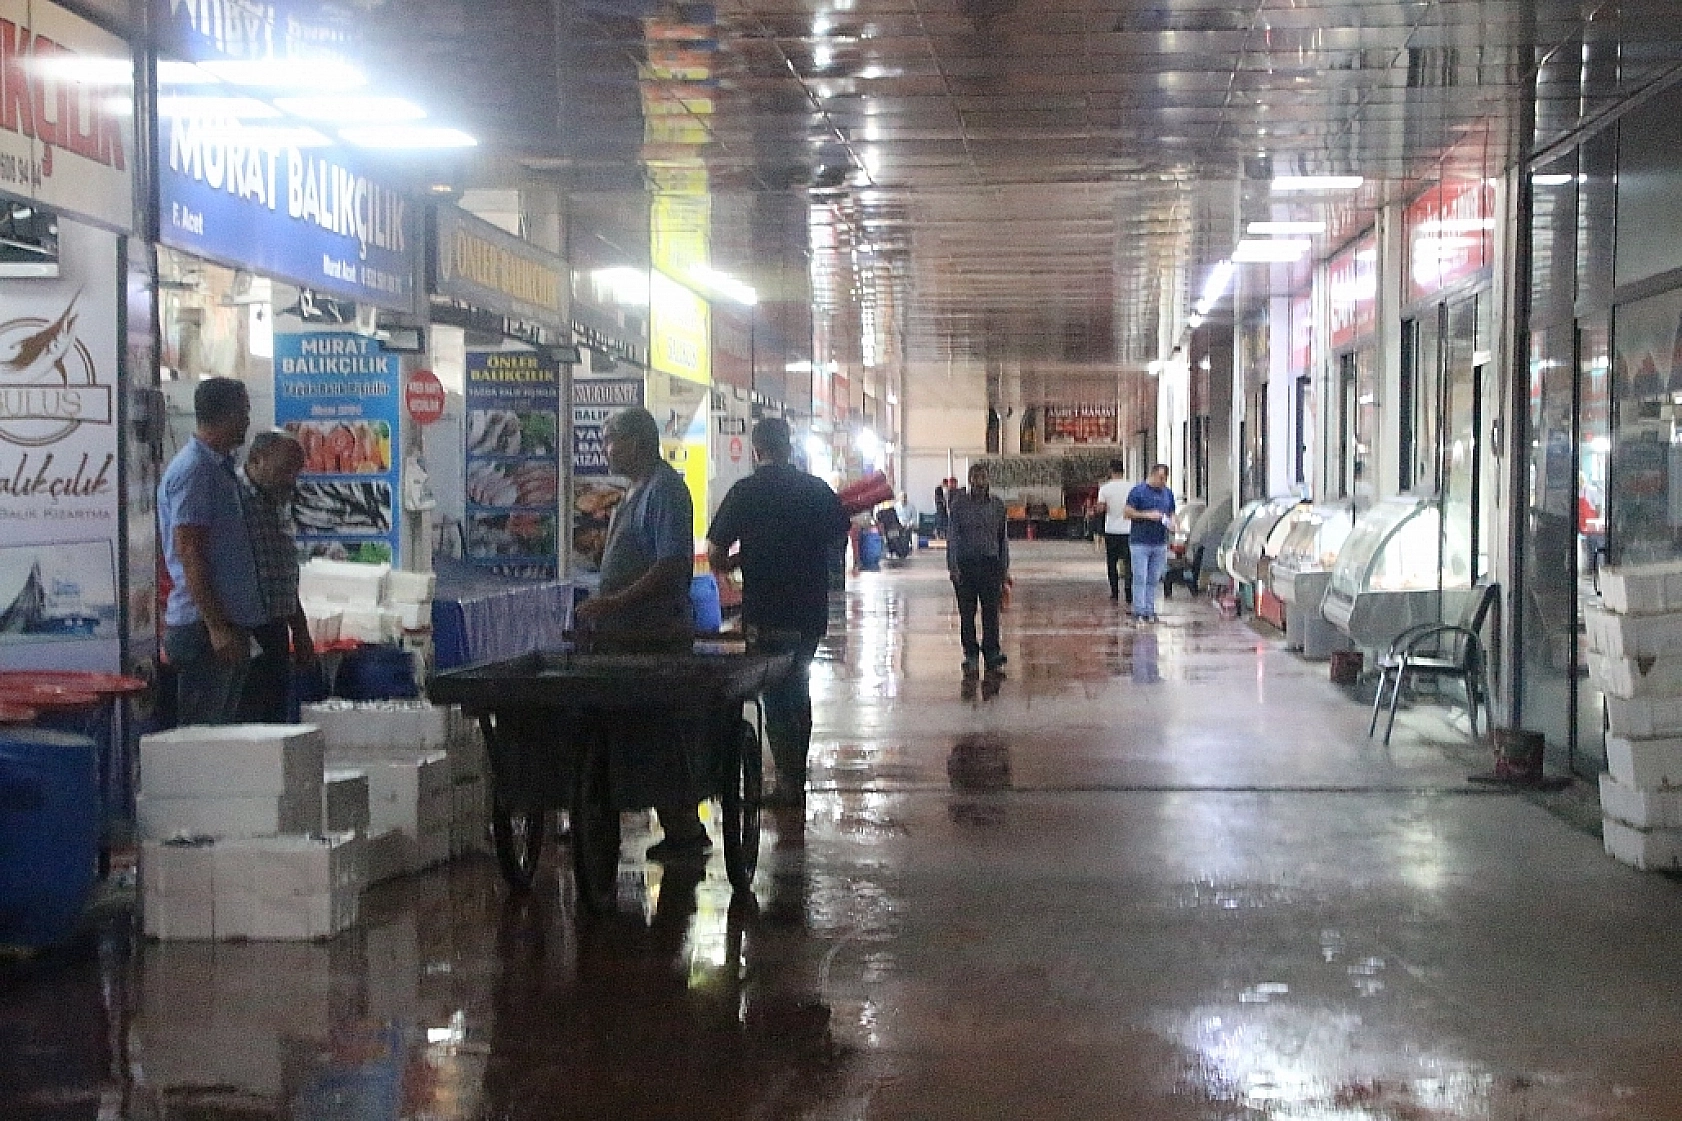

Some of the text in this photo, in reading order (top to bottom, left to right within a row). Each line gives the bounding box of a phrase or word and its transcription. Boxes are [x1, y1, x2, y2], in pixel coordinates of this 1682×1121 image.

[0, 17, 125, 177] KÇILIK
[169, 100, 405, 261] MURAT BALIKÇILIK
[301, 339, 369, 355] MURAT
[282, 357, 389, 375] BALIKÇILIK
[0, 390, 81, 416] ULUS
